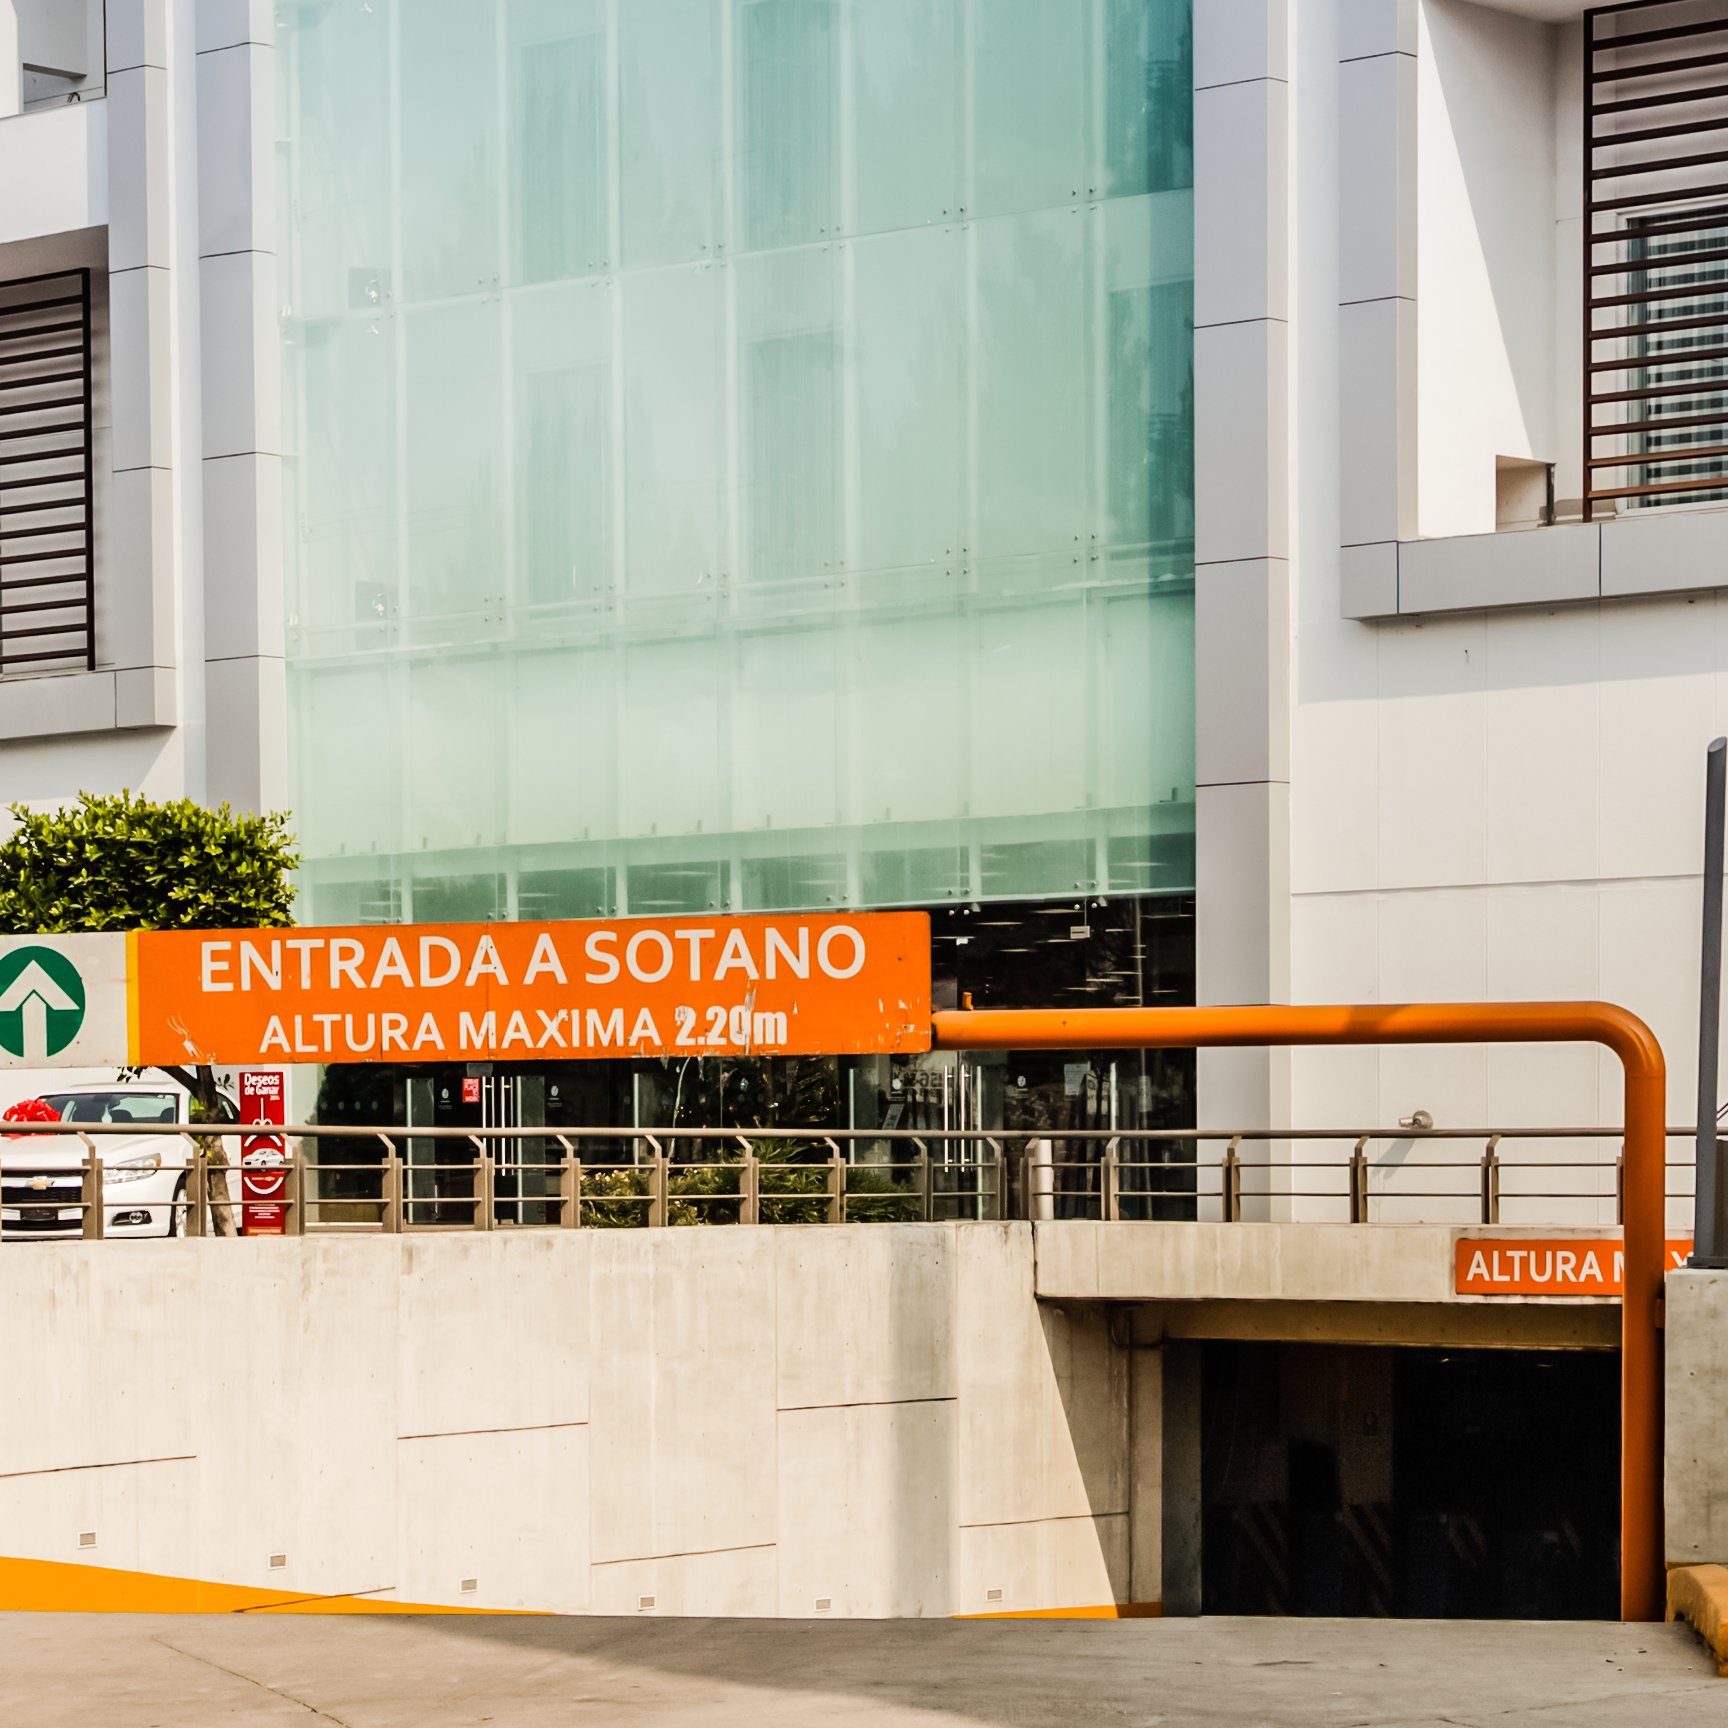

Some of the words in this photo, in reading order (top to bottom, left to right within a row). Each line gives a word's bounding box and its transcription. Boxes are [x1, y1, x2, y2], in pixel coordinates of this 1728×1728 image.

[200, 934, 510, 993] ENTRADA
[522, 932, 569, 986] A
[584, 925, 867, 985] SOTANO
[258, 1011, 446, 1054] ALTURA
[458, 1007, 663, 1051] MAXIMA
[674, 1004, 788, 1047] 2.20m
[244, 1073, 280, 1086] Deseos
[244, 1085, 255, 1096] de
[256, 1084, 280, 1095] Ganar
[1465, 1249, 1604, 1283] ALTURA
